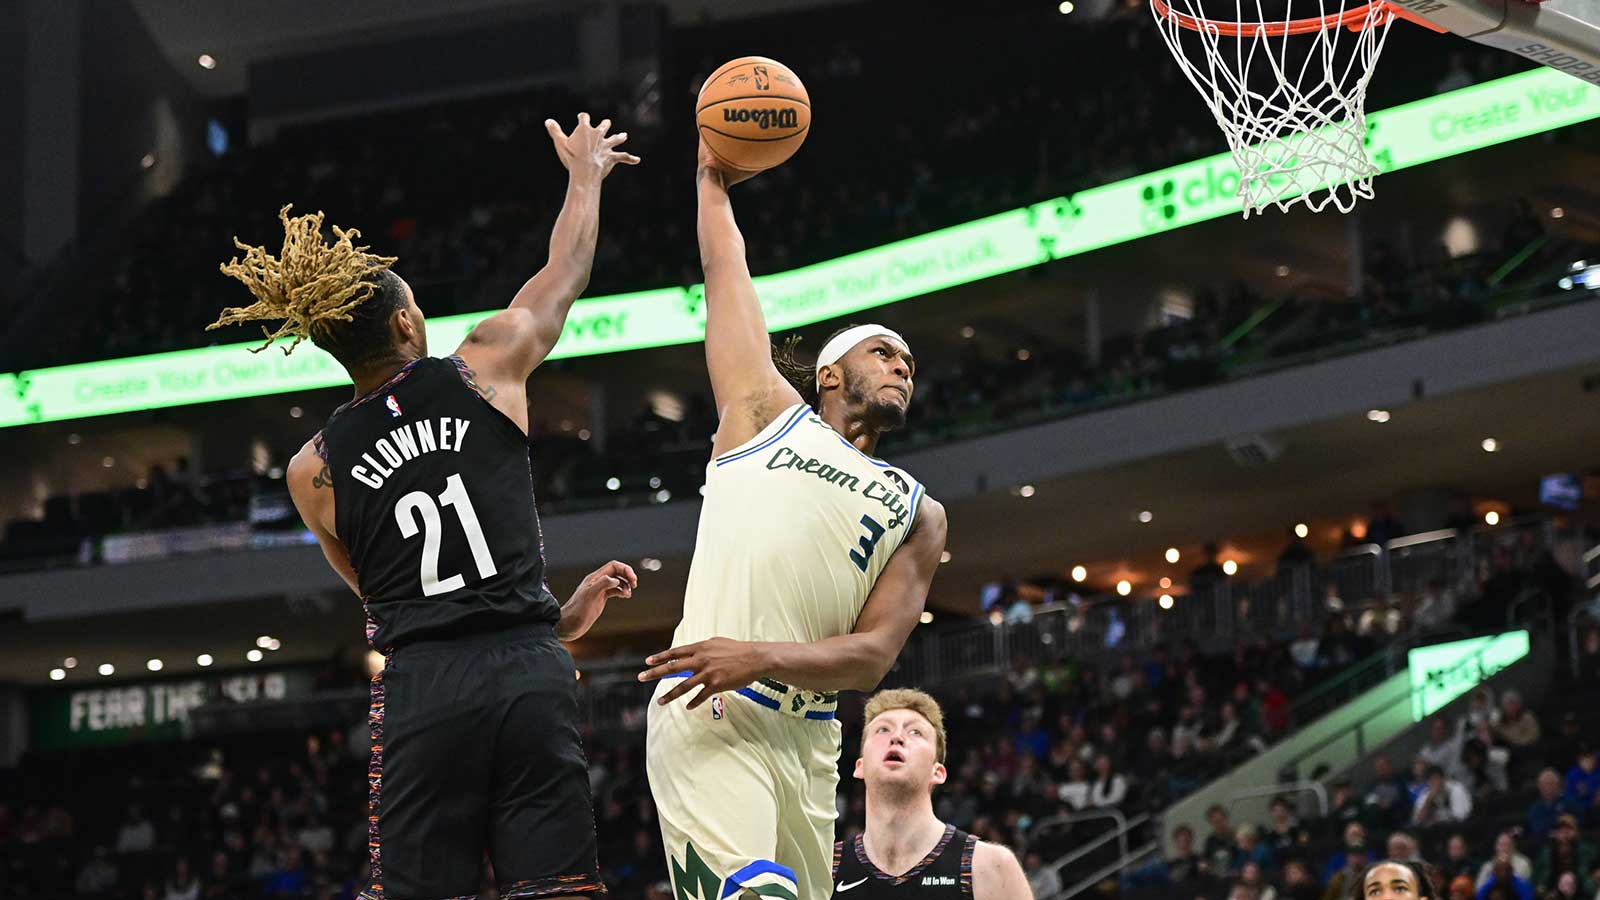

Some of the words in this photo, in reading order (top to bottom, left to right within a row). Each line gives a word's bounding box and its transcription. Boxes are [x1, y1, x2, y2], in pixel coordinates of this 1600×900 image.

[723, 108, 798, 129] Wilson
[1429, 102, 1520, 140] Create
[1525, 82, 1594, 113] Your
[885, 256, 938, 286] Own
[74, 376, 150, 403] Create
[156, 368, 206, 392] Your
[212, 360, 268, 386] Own
[351, 417, 471, 489] CLOWNEY
[766, 447, 861, 492] Cream
[862, 480, 909, 529] City
[394, 473, 498, 597] 21
[849, 514, 886, 573] 3
[921, 876, 931, 885] All
[932, 876, 939, 885] In
[940, 876, 955, 885] Won
